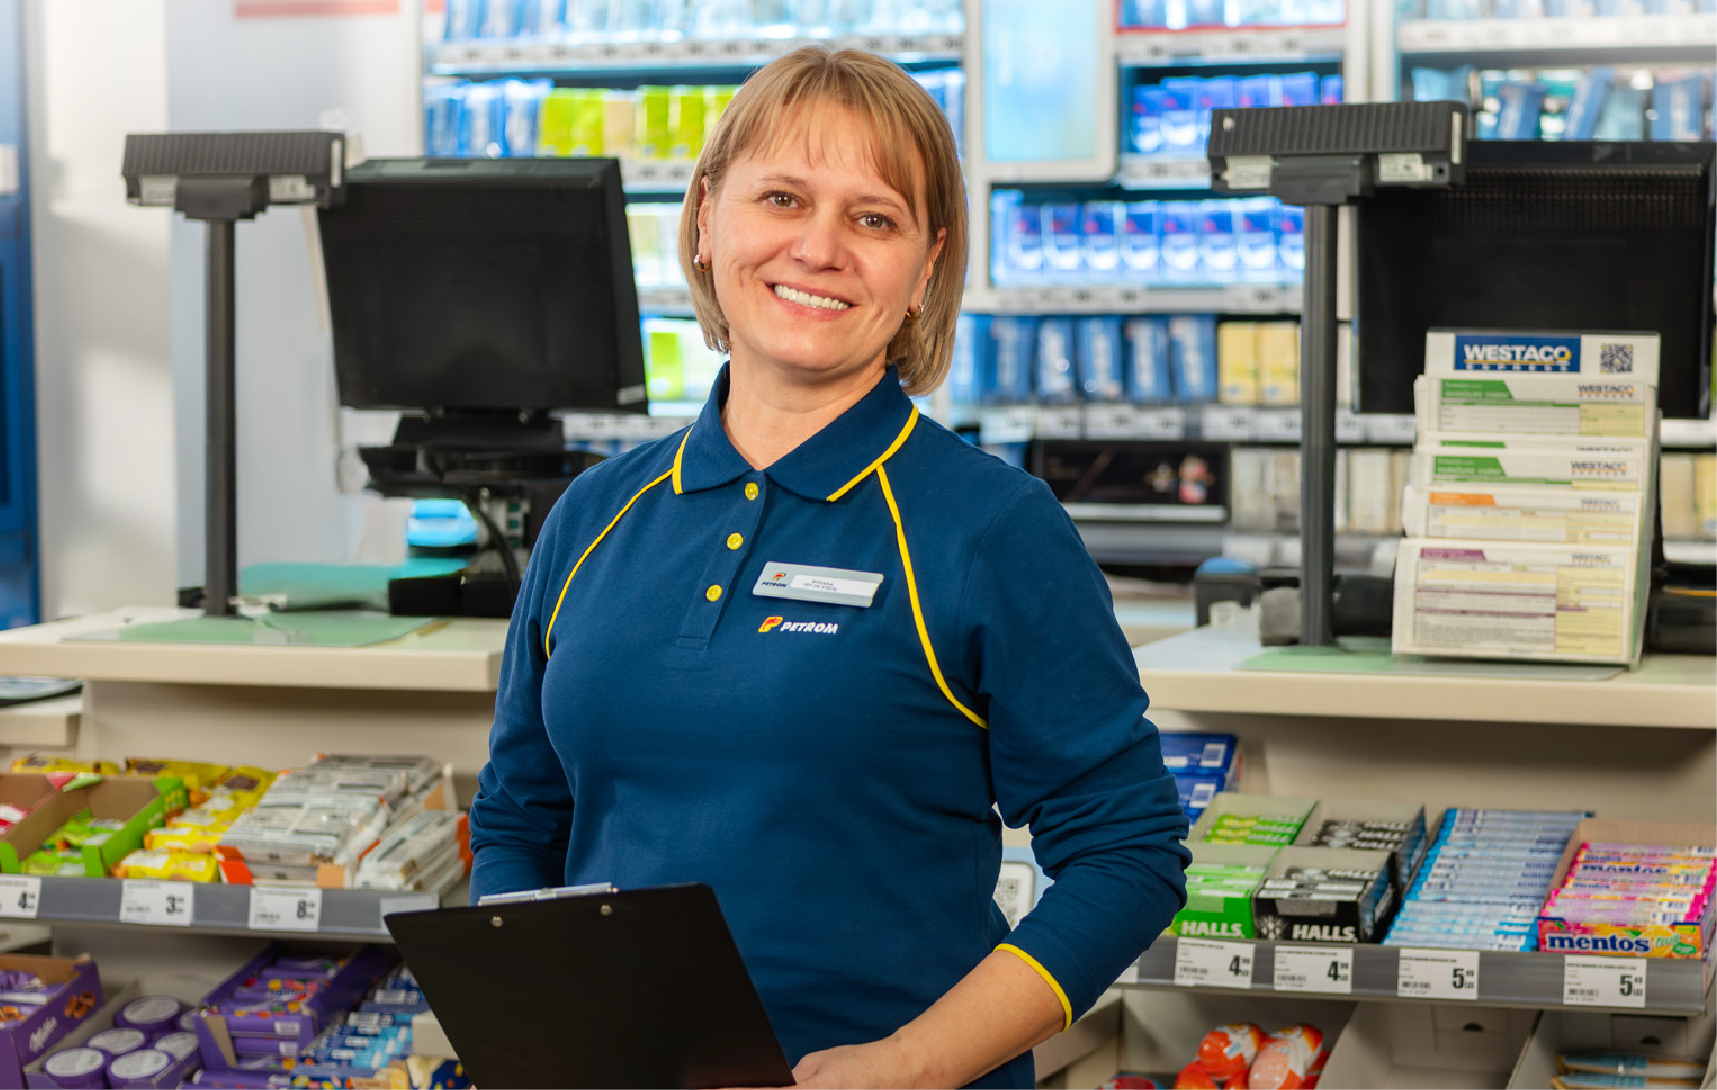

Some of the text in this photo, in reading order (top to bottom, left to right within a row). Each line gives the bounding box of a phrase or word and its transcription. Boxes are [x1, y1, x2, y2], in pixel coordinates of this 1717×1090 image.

[1463, 344, 1572, 361] WESTACO
[1578, 384, 1635, 394] WESTACO
[1570, 461, 1628, 471] WESTACO
[780, 622, 838, 634] PETROM
[165, 895, 176, 914] 3
[1181, 921, 1242, 937] HALLS
[1292, 924, 1356, 941] HALLS
[1547, 934, 1650, 952] mentos
[1229, 955, 1241, 977] 4
[1327, 960, 1340, 981] 4
[1452, 968, 1465, 989] 5
[1619, 974, 1633, 996] 5
